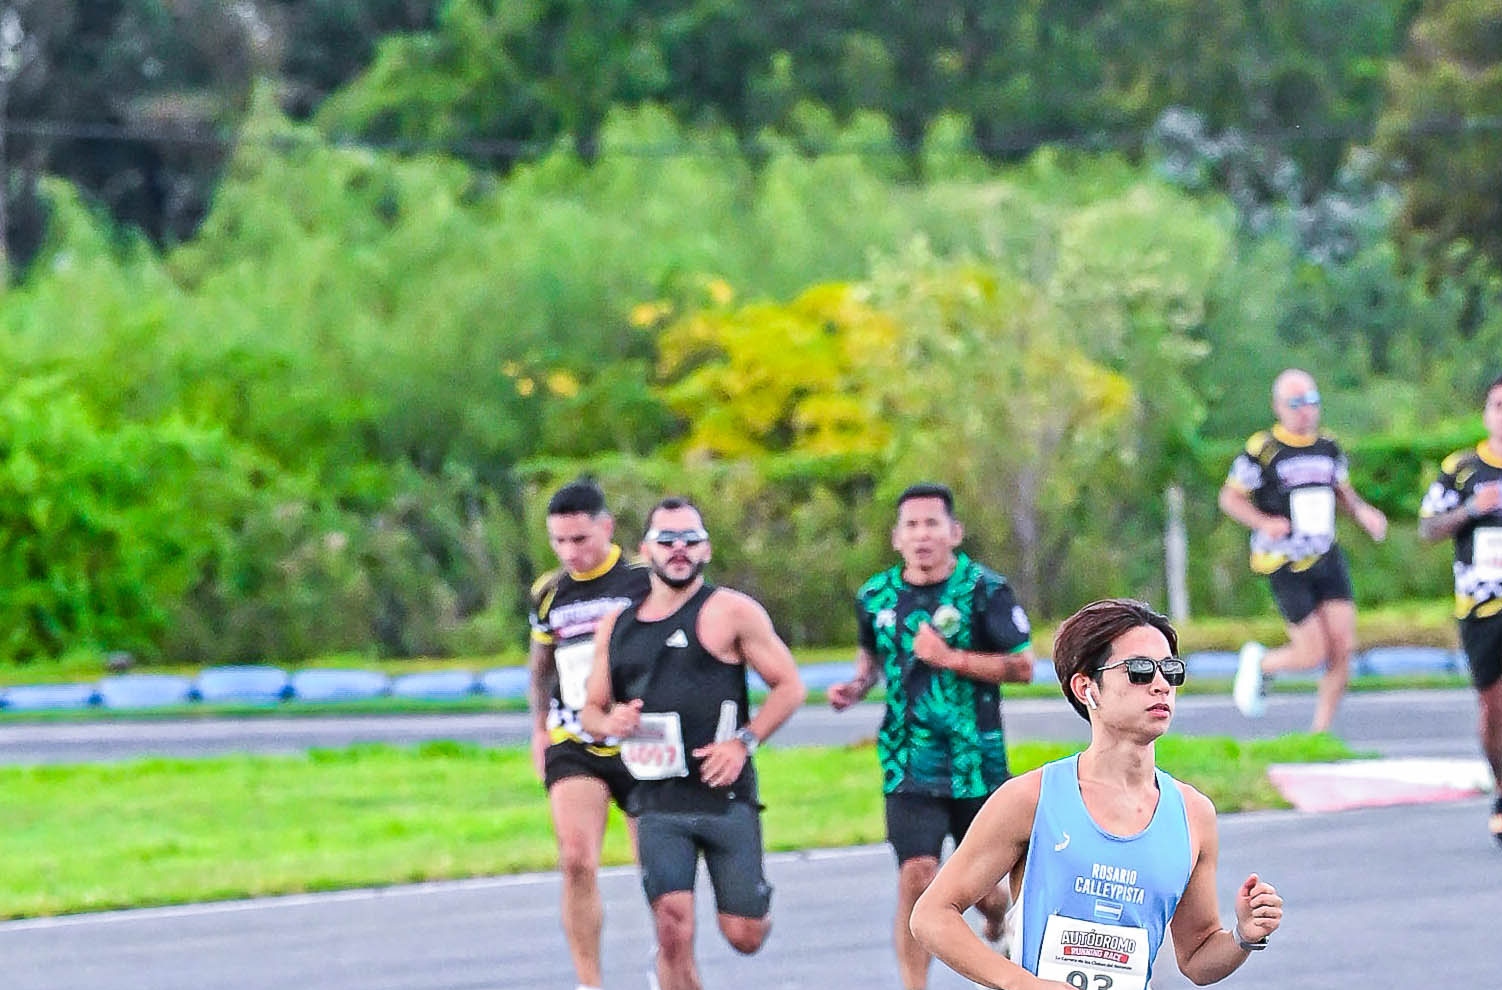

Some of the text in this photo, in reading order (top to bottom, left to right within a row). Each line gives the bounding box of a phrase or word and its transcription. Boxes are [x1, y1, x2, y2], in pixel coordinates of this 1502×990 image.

[1092, 863, 1137, 885] ROSARIO
[1074, 876, 1145, 904] CALLEYPISTA
[1071, 947, 1122, 962] RUNNING RACE
